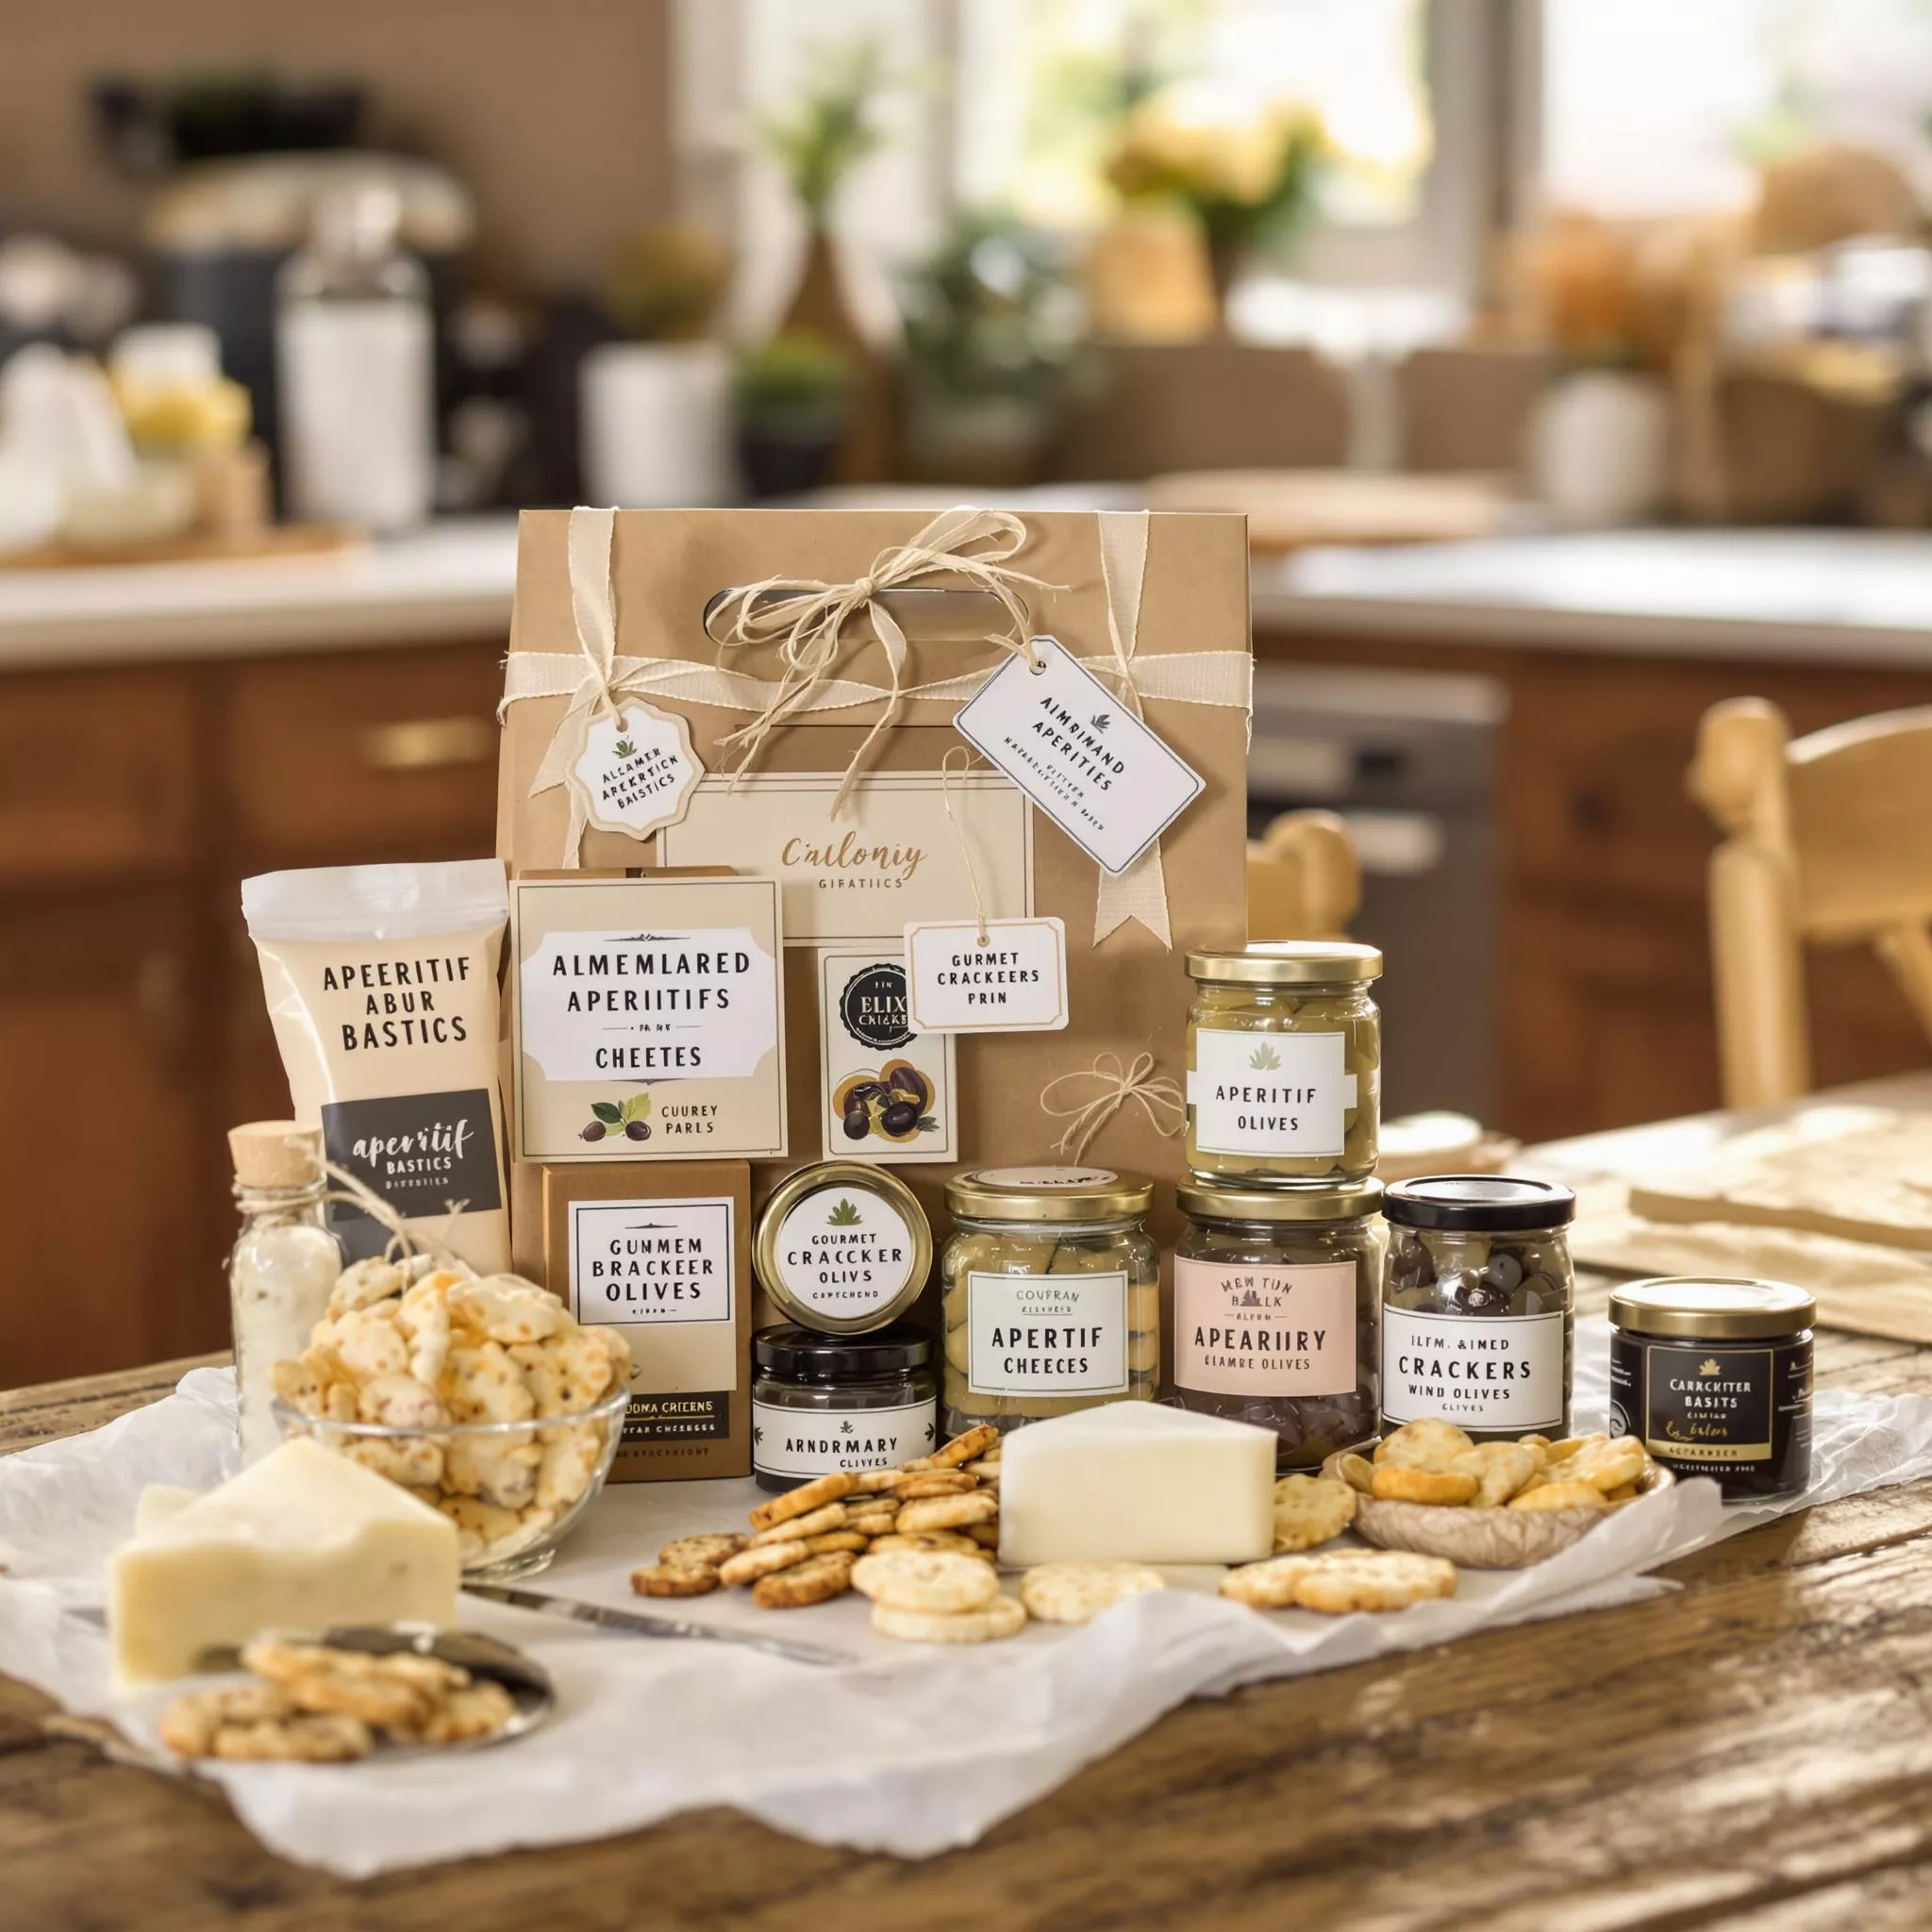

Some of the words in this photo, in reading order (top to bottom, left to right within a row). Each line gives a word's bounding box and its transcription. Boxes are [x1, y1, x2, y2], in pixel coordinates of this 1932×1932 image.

[1032, 722, 1112, 791] APERITIES
[553, 953, 750, 976] ALMEMLARED
[952, 953, 1018, 966] GURMET
[323, 957, 472, 991] APEERITIF
[938, 970, 1039, 985] CRACKEERS
[365, 991, 435, 1015] ABUR
[568, 989, 729, 1011] APERIITIFS
[969, 992, 1007, 1005] PRIN
[342, 1016, 468, 1051] BASTICS
[596, 1047, 701, 1068] CHEETES
[1216, 1086, 1316, 1103] APERITIF
[662, 1106, 717, 1117] CUUREY
[1238, 1116, 1298, 1130] OLIVES
[387, 1157, 451, 1174] BASTICS
[812, 1234, 876, 1244] GOURMET
[592, 1259, 712, 1276] BRACKEER
[820, 1271, 872, 1283] OLIVS
[607, 1282, 701, 1301] OLIVES
[991, 1326, 1103, 1348] APERTIF
[1004, 1357, 1088, 1374] CHEECES
[1262, 1358, 1310, 1370] OLIVES
[1399, 1356, 1531, 1379] CRACKERS
[1454, 1389, 1510, 1399] OLIVES
[786, 1438, 897, 1453] ARNDRMARY
